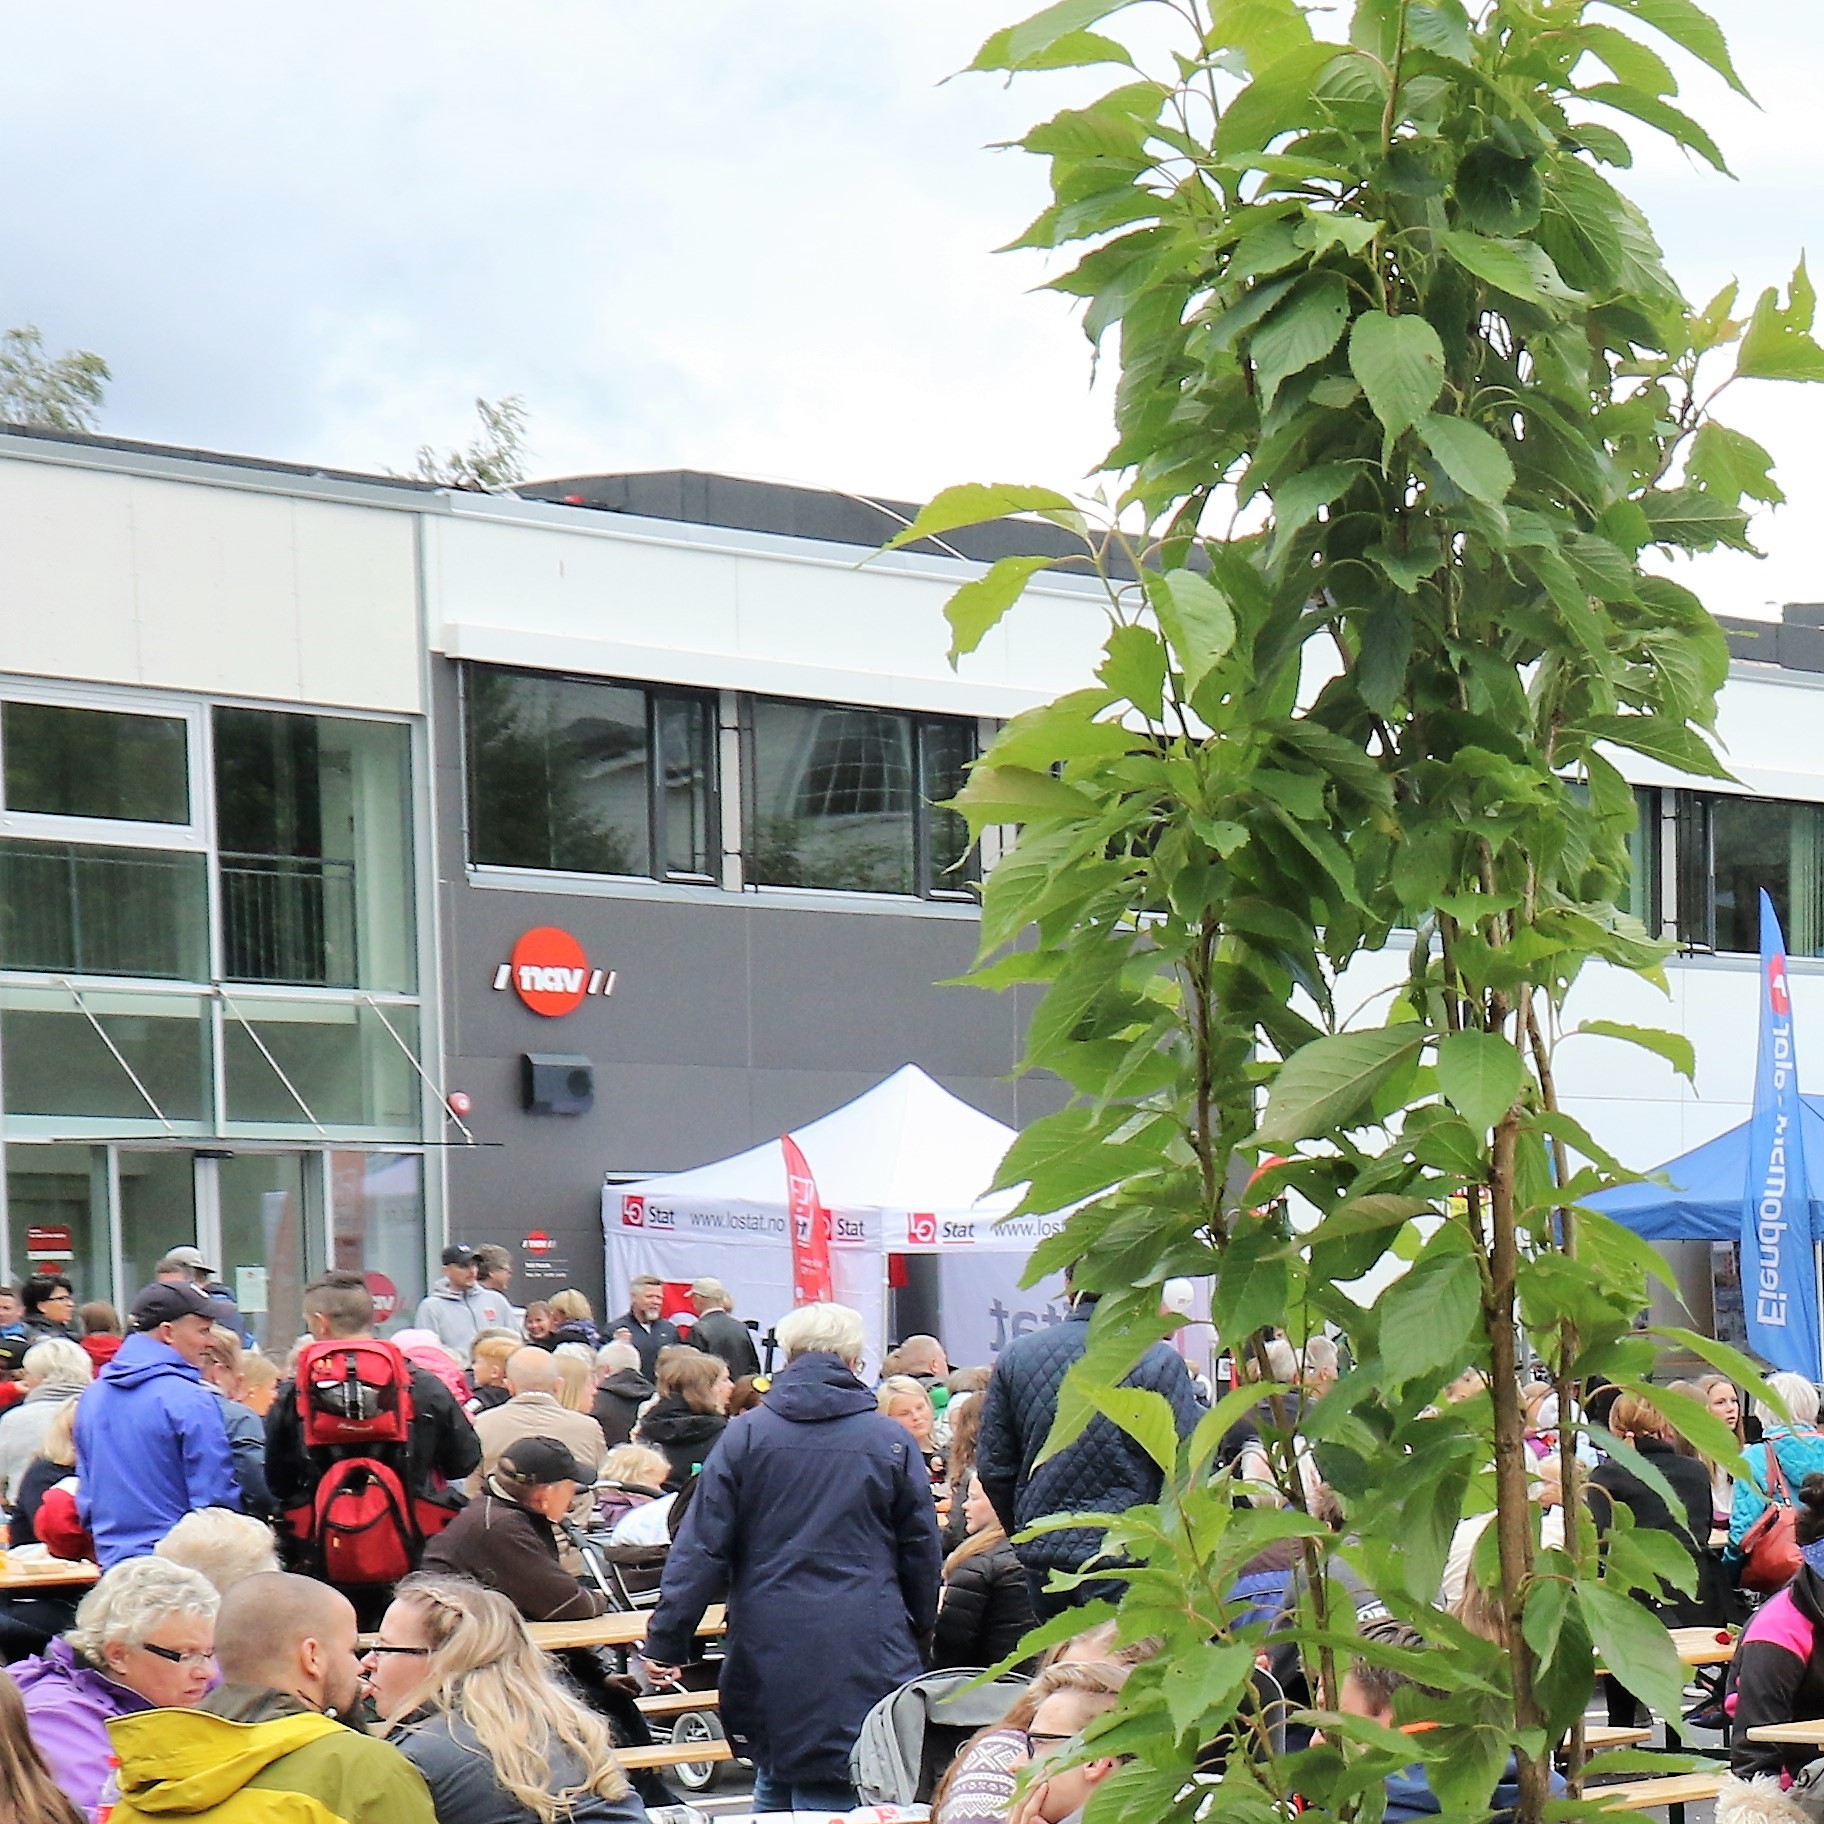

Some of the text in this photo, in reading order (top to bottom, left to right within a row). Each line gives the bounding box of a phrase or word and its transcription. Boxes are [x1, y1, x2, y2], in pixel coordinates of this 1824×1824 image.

[518, 964, 585, 994] nav
[648, 1206, 675, 1226] Stat
[690, 1209, 785, 1233] www.lostat.no
[836, 1218, 864, 1237] Stat
[942, 1221, 975, 1239] Stat
[993, 1218, 1067, 1239] www.los
